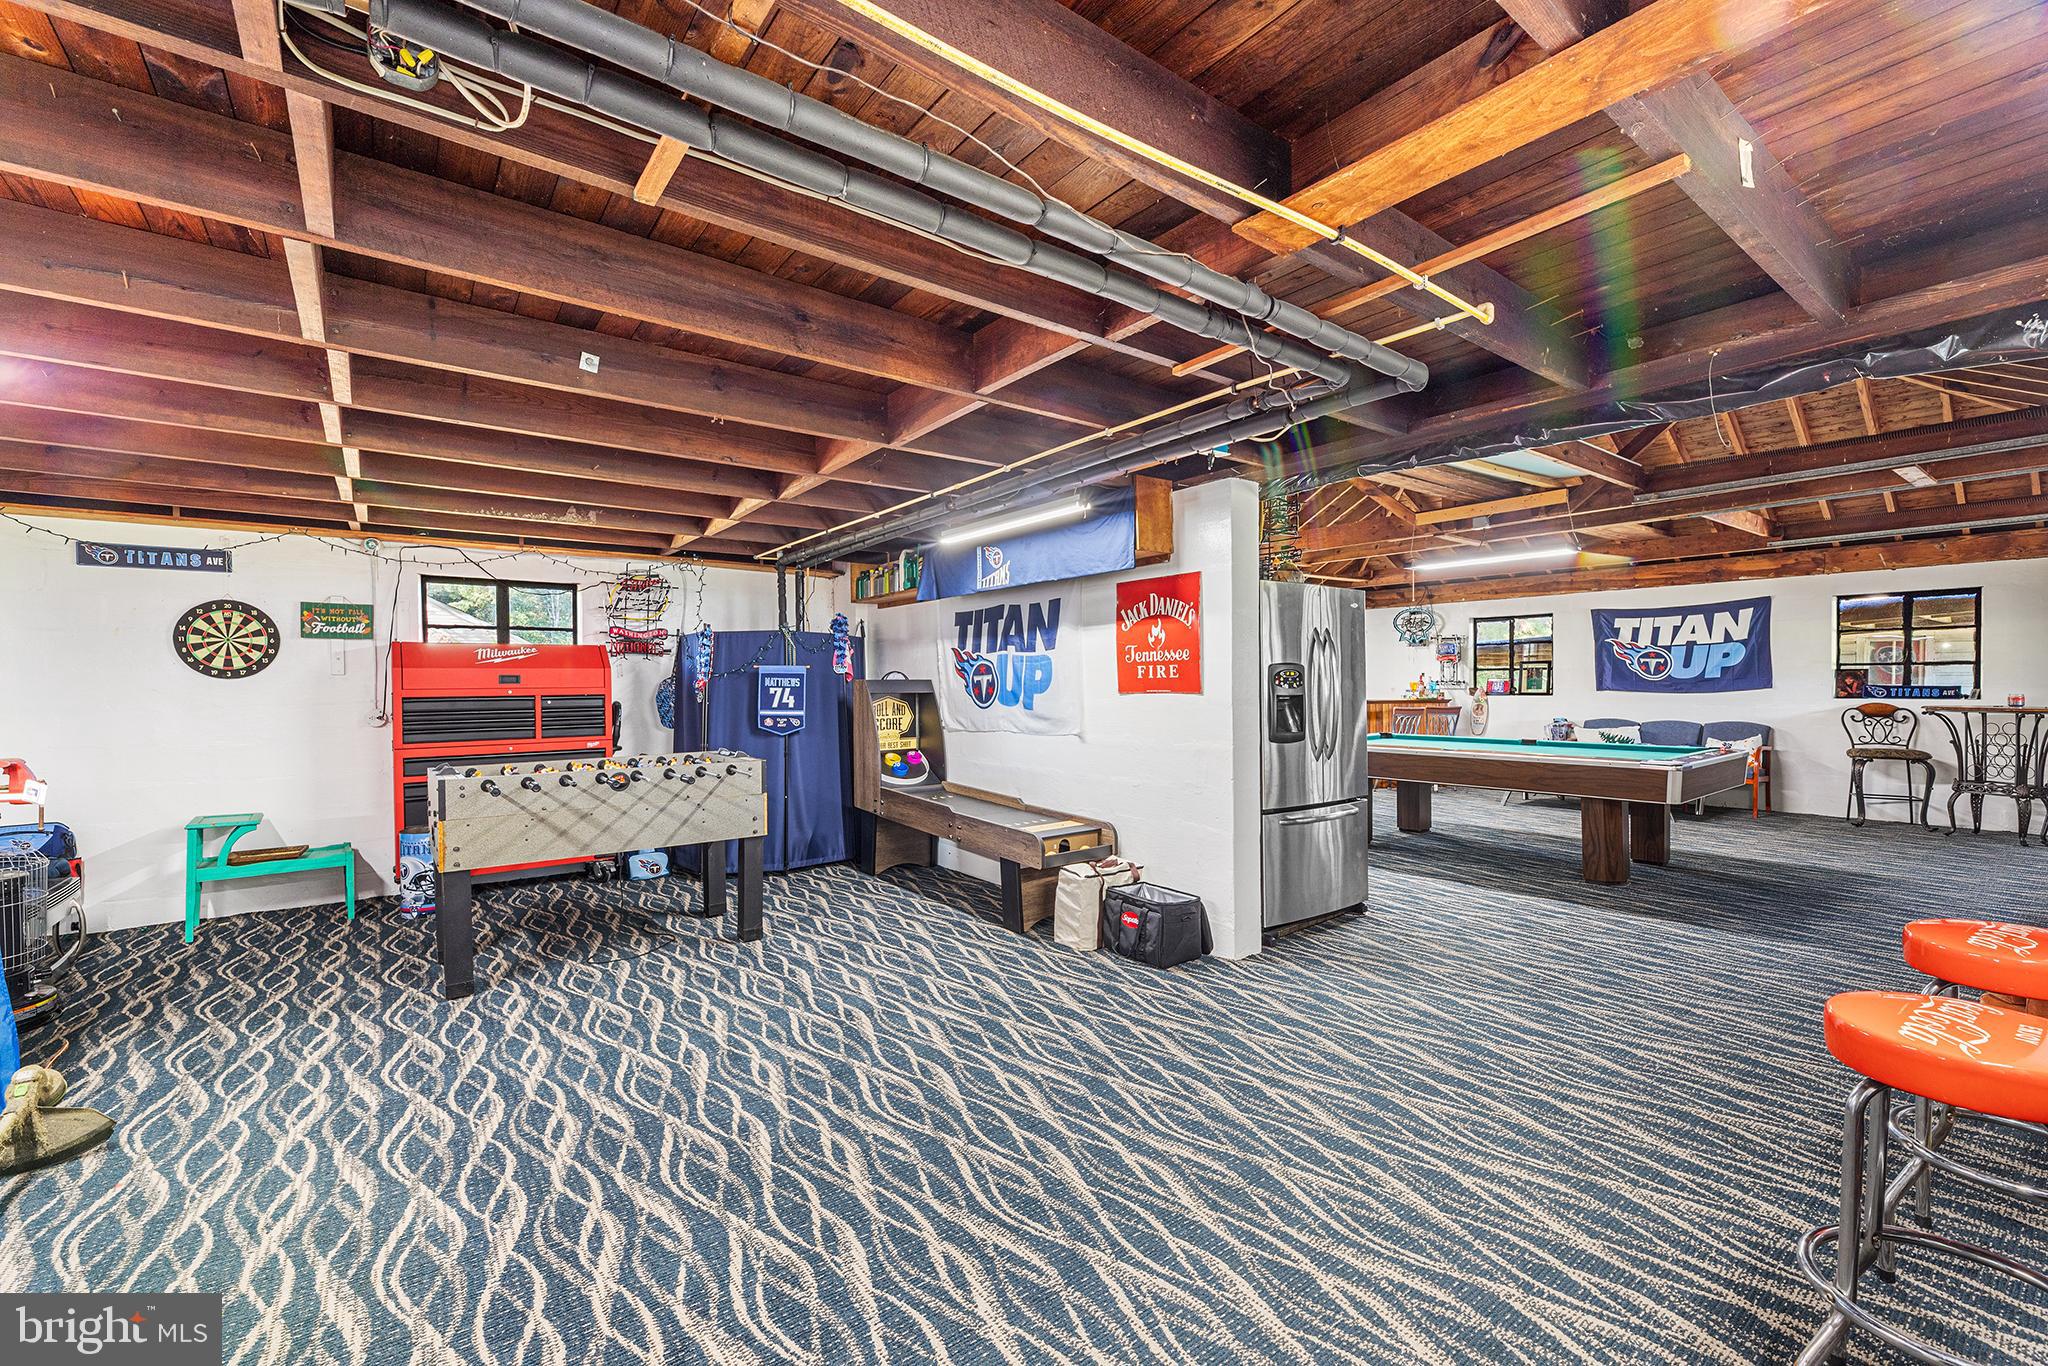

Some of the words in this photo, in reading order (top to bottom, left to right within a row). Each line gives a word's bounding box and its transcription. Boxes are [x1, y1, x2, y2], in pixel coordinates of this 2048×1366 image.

[124, 549, 202, 567] TITANS
[206, 557, 224, 566] AVE
[1121, 600, 1148, 631] JACK
[312, 622, 366, 634] Football
[612, 628, 664, 638] WASHINGTON
[954, 598, 1061, 654] TITAN
[1614, 608, 1754, 646] TITAN
[473, 647, 538, 660] Milwaukee
[1125, 645, 1190, 663] Tennessee
[1670, 642, 1746, 679] UP
[1137, 664, 1179, 678] FIRE
[764, 677, 800, 687] MATTHEWS
[997, 653, 1053, 711] UP
[769, 688, 795, 708] 74
[1890, 687, 1940, 697] TITANS
[892, 702, 906, 716] AND
[1898, 995, 2004, 1060] Coca-Cola
